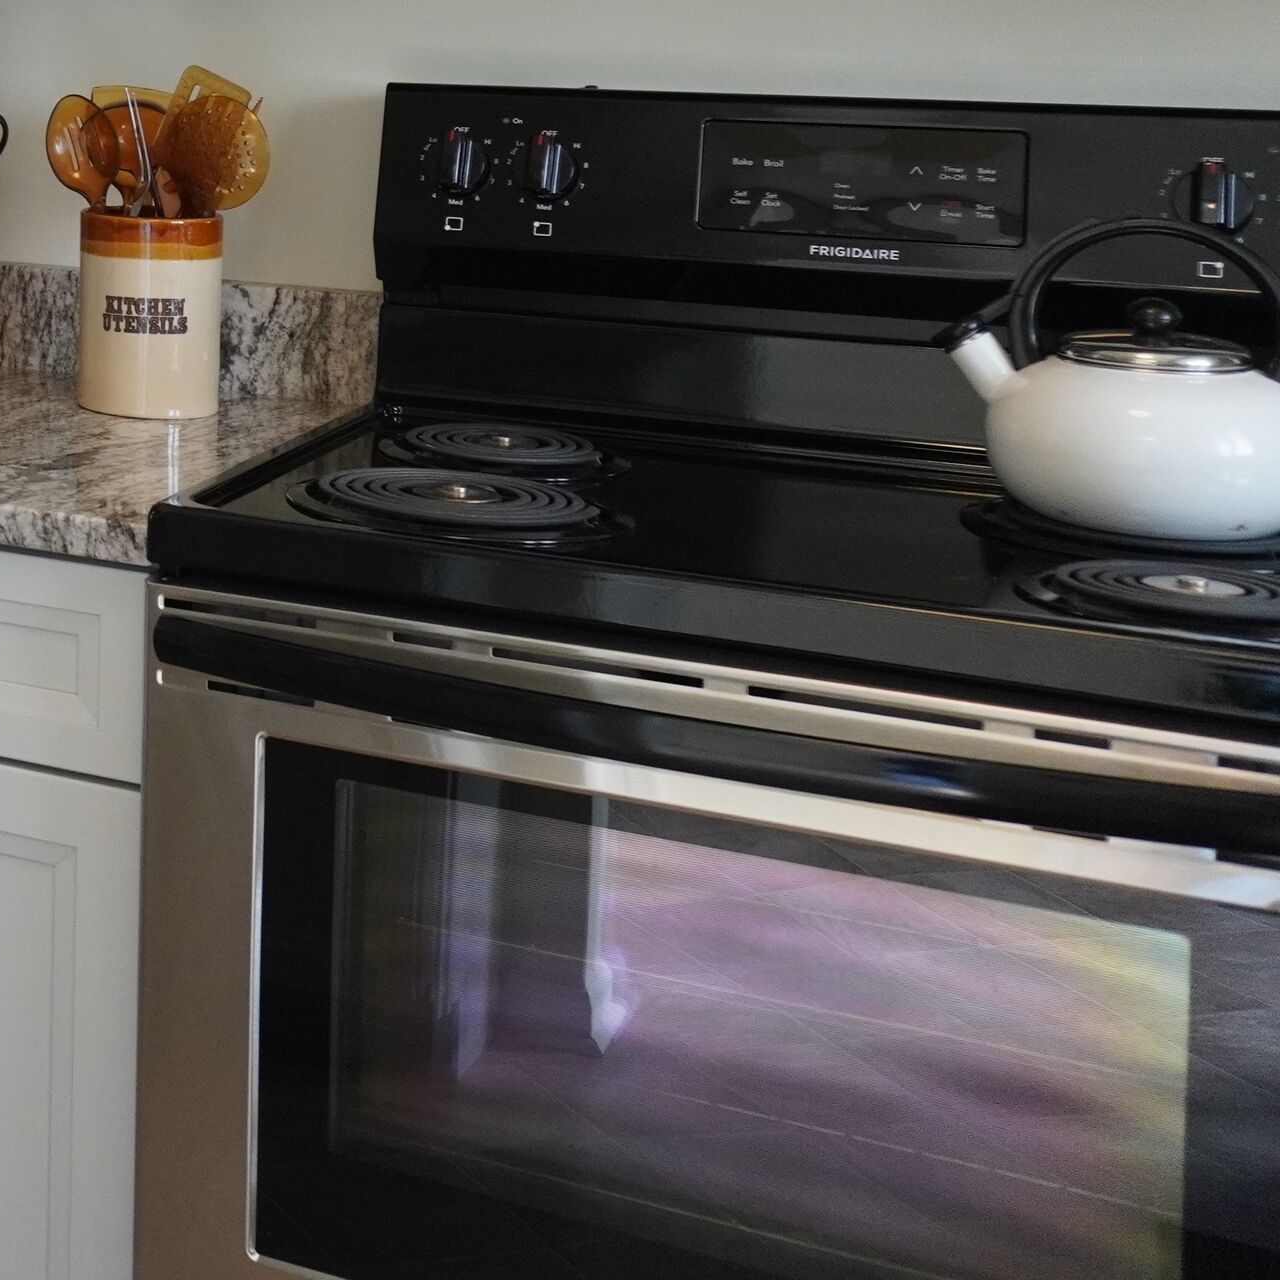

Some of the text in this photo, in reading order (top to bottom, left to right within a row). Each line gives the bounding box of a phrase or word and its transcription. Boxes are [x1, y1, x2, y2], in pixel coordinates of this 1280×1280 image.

[512, 117, 524, 125] On
[732, 158, 784, 167] Bake Broil
[809, 245, 900, 260] FRIGIDAIRE
[105, 295, 186, 317] KITCHEN
[102, 314, 188, 334] UTENSILS
